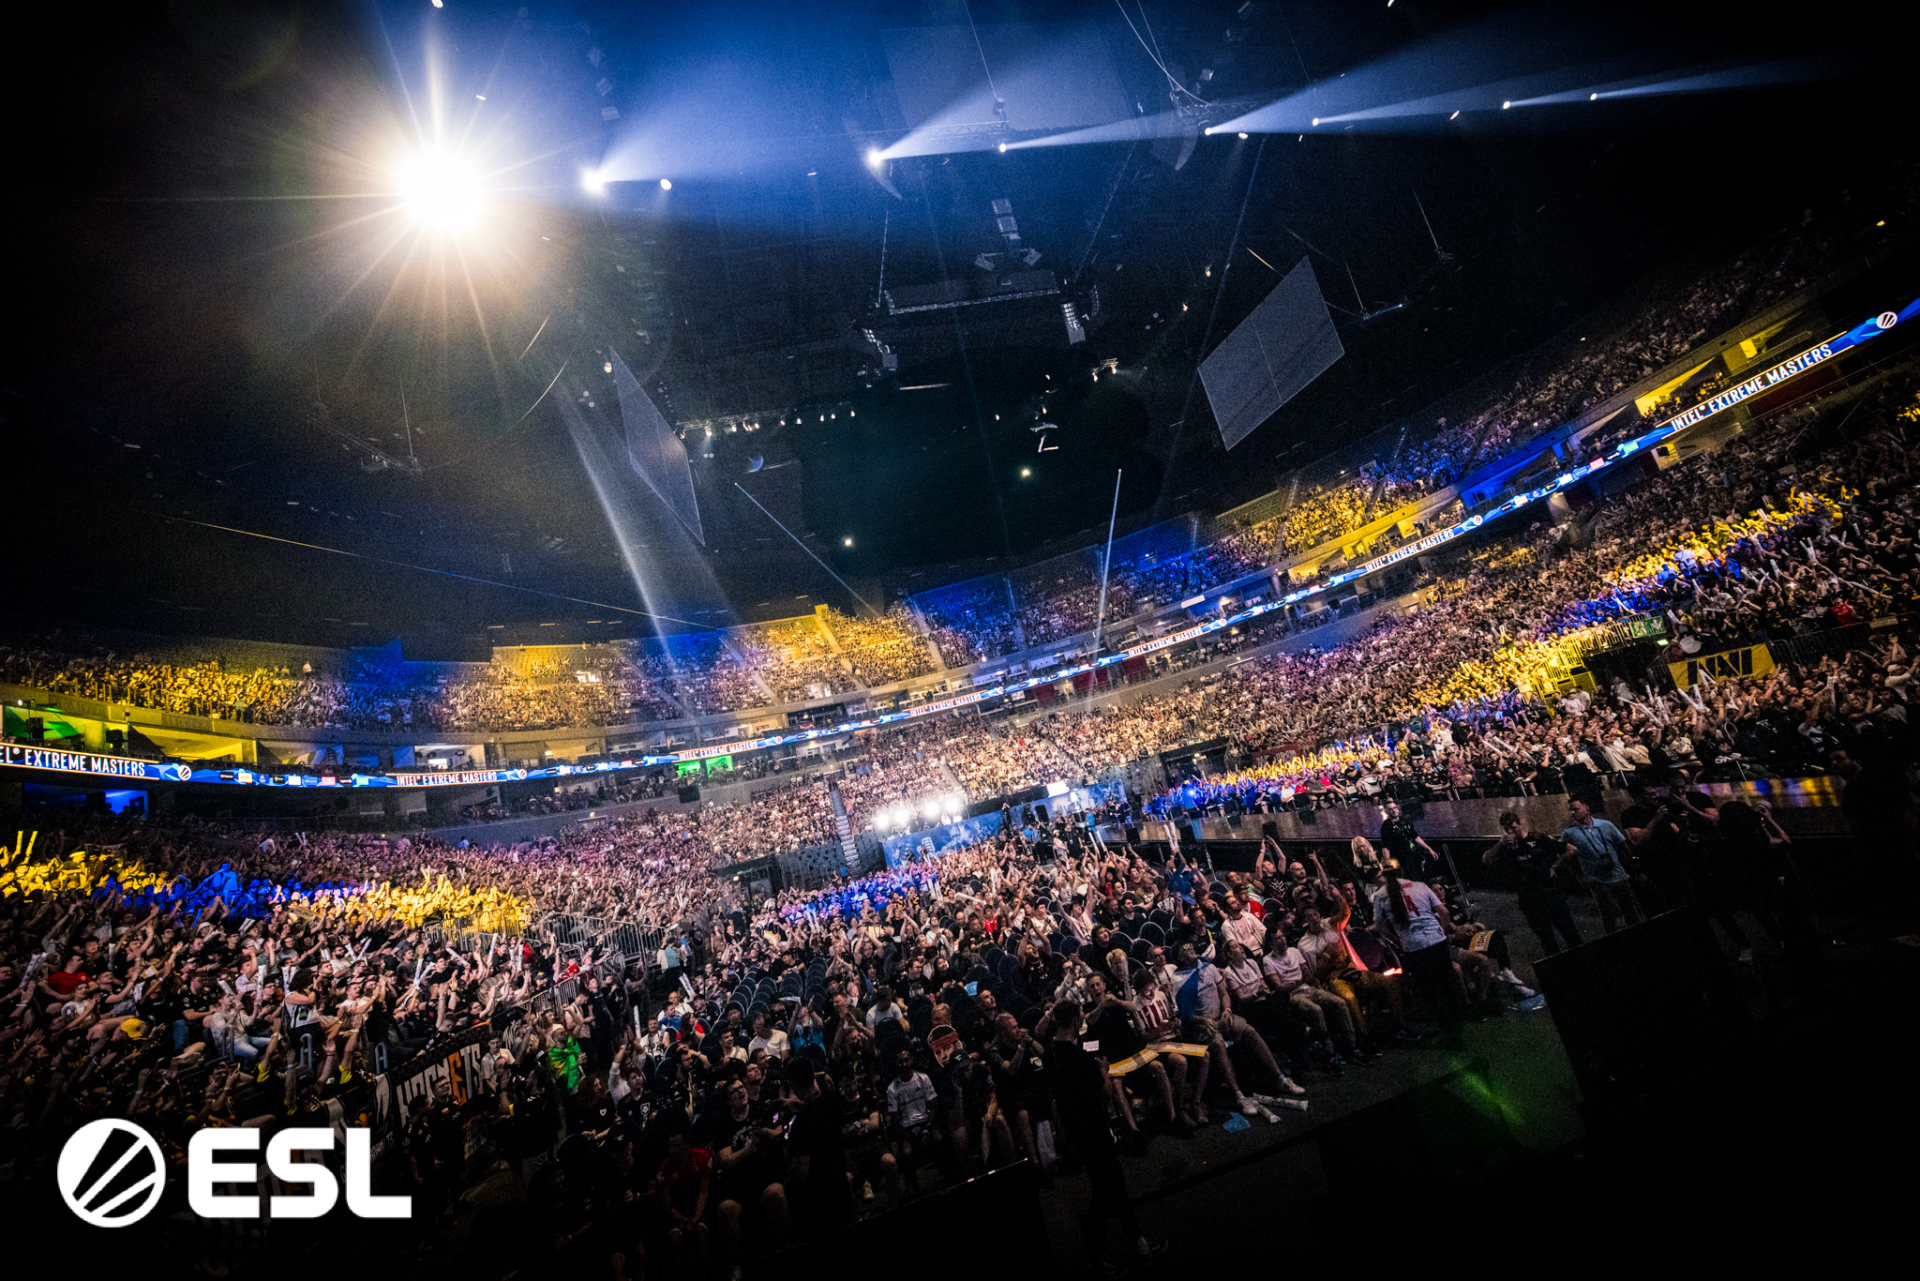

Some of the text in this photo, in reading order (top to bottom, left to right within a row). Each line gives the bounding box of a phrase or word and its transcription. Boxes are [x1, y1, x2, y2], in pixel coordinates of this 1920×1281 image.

[1707, 376, 1765, 413] EXTREME
[1765, 344, 1832, 385] MASTERS
[1387, 543, 1418, 562] EXTREME
[1419, 528, 1454, 551] MASTERS
[1148, 636, 1173, 650] EXTREME
[1175, 626, 1203, 642] MASTERS
[729, 741, 758, 753] MASTERS
[24, 748, 87, 771] EXTREME
[90, 756, 145, 777] MASTERS
[422, 773, 461, 786] EXTREME
[462, 771, 498, 784] MASTERS
